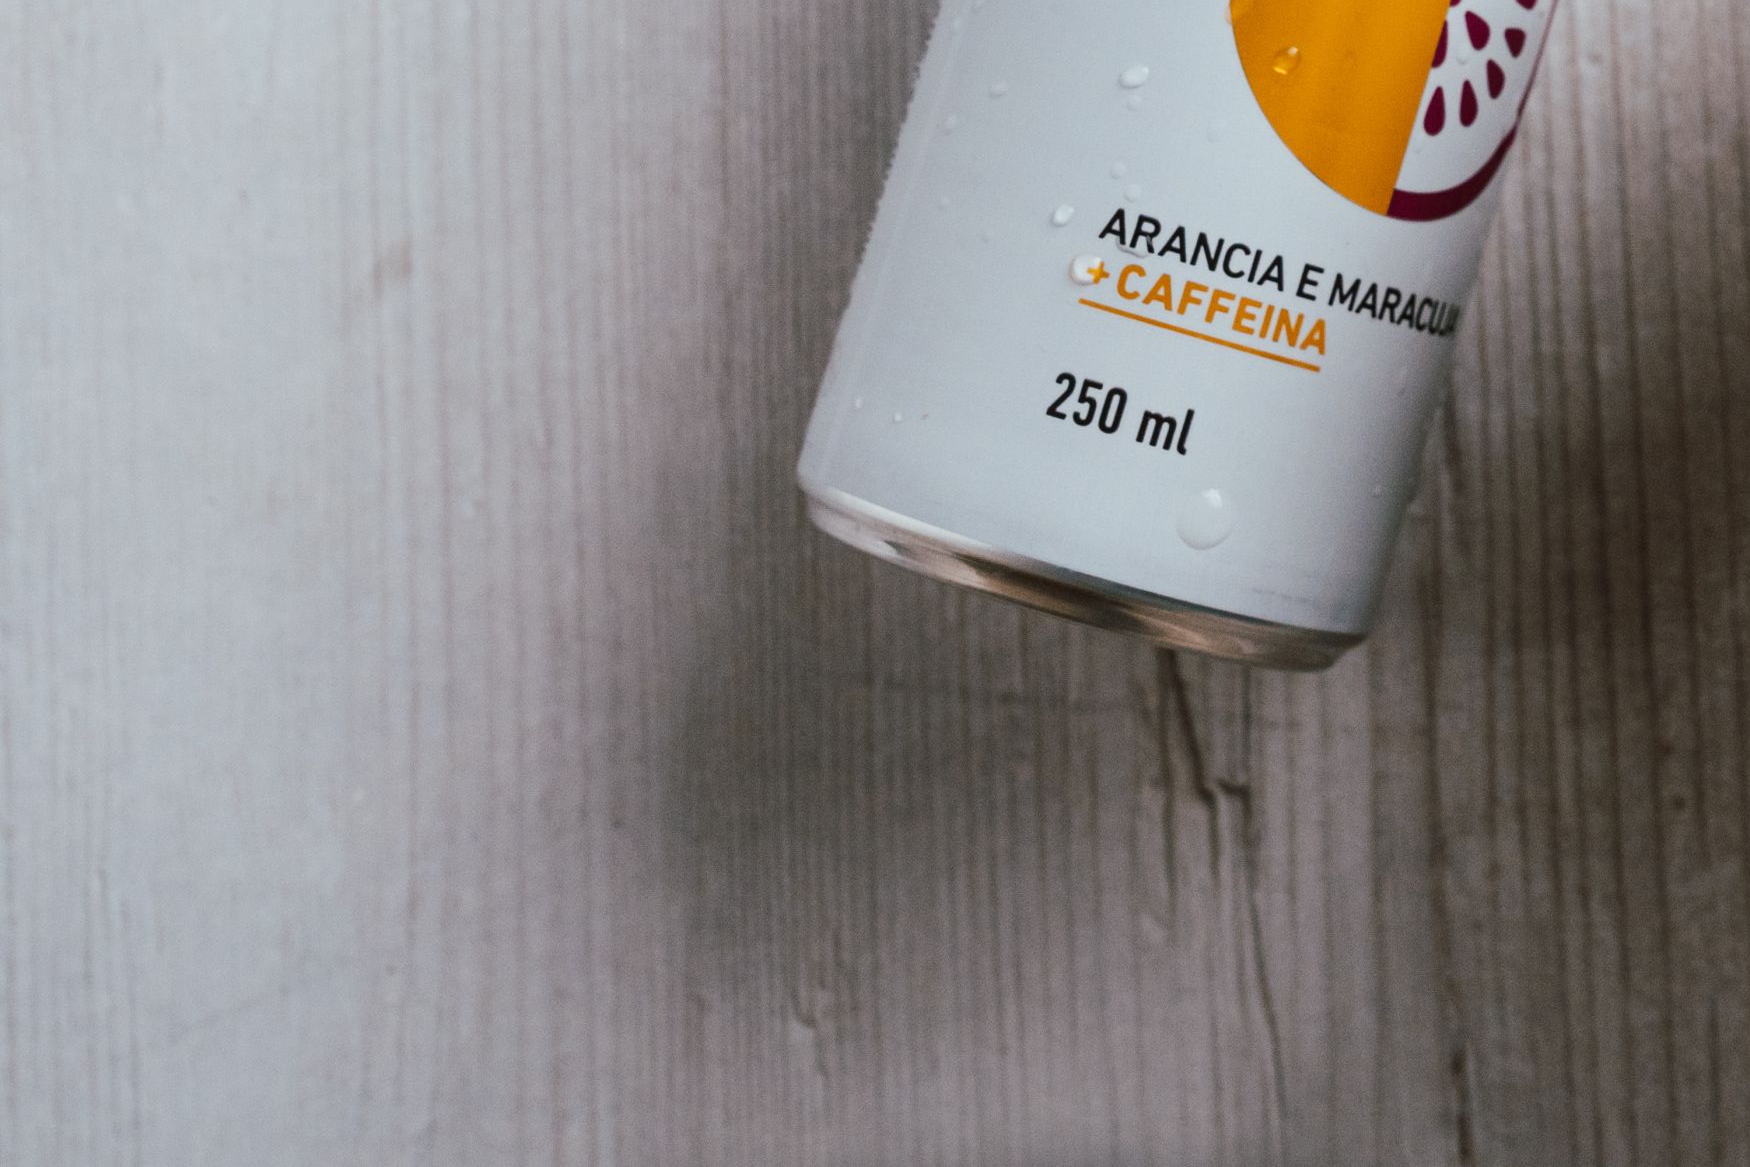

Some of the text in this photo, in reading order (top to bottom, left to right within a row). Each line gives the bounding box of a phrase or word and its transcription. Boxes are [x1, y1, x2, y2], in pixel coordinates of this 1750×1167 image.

[1098, 207, 1285, 292] ARANCIA
[1295, 263, 1325, 302] E
[1045, 371, 1196, 456] 250 ml
